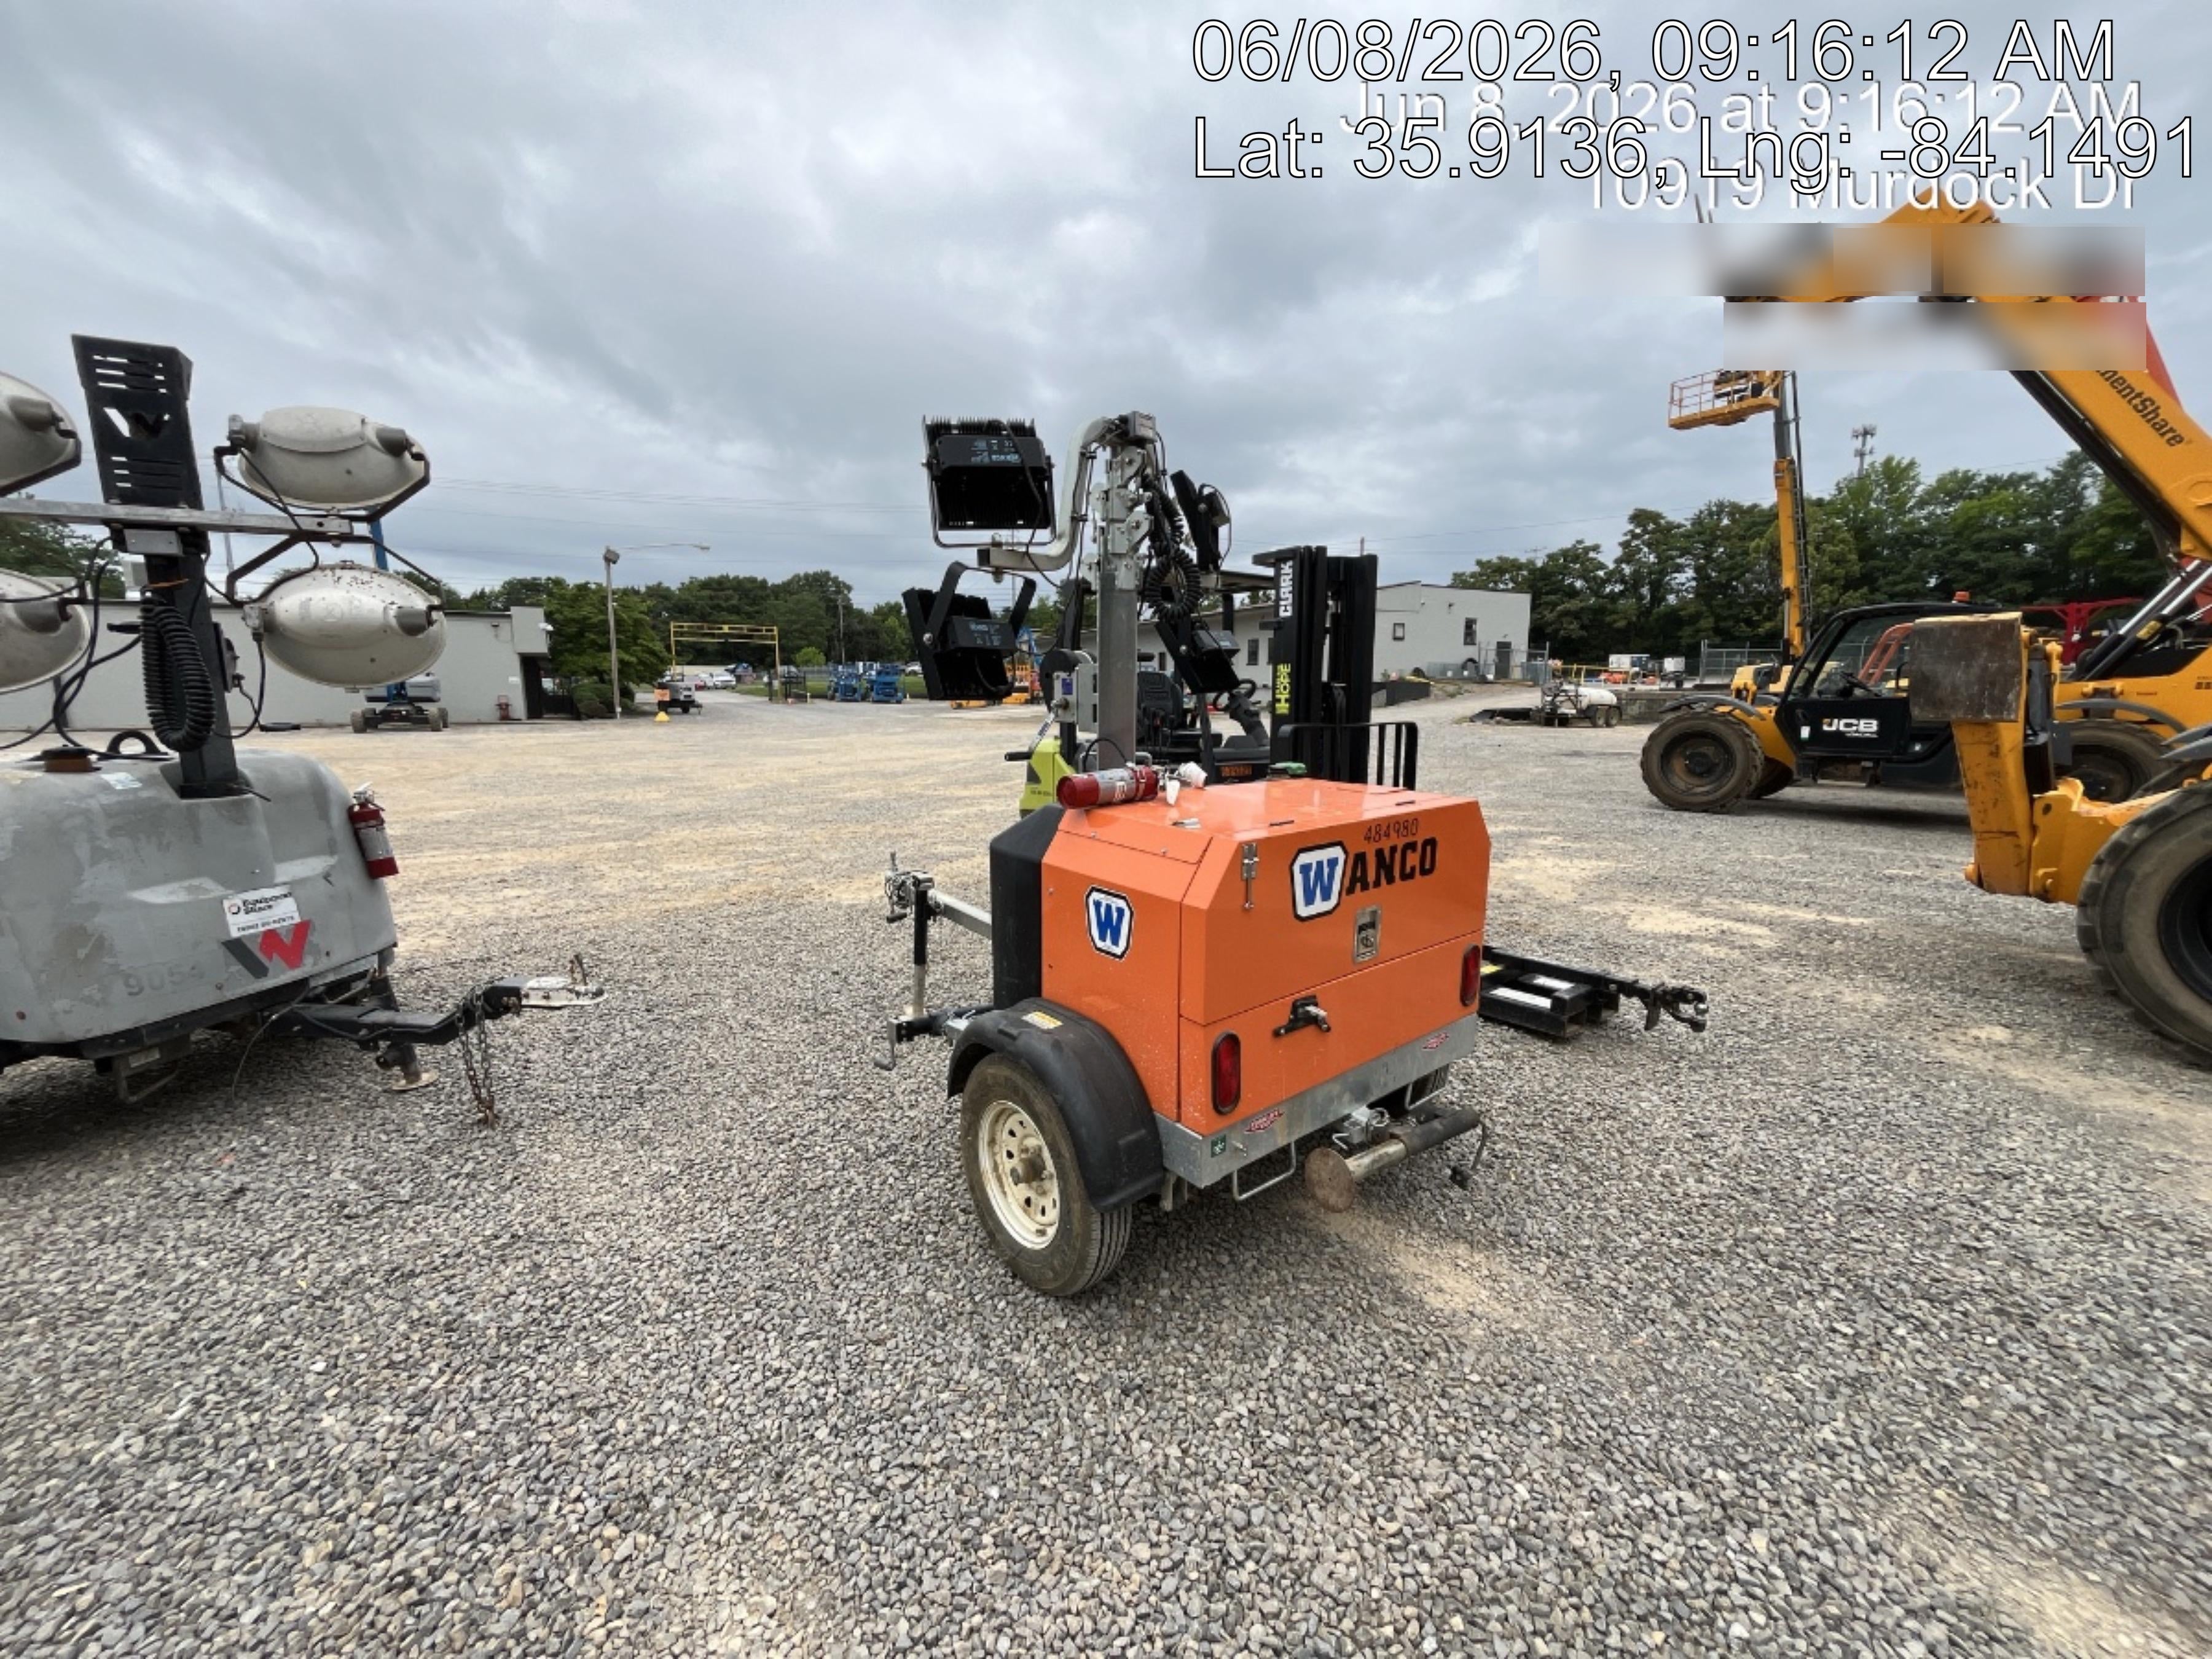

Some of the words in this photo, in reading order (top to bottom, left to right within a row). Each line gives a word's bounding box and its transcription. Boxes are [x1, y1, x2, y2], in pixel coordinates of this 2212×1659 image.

[1279, 560, 1293, 617] CLARK
[1822, 718, 1878, 732] JCB
[1363, 818, 1419, 844] 484980
[1093, 899, 1125, 948] W
